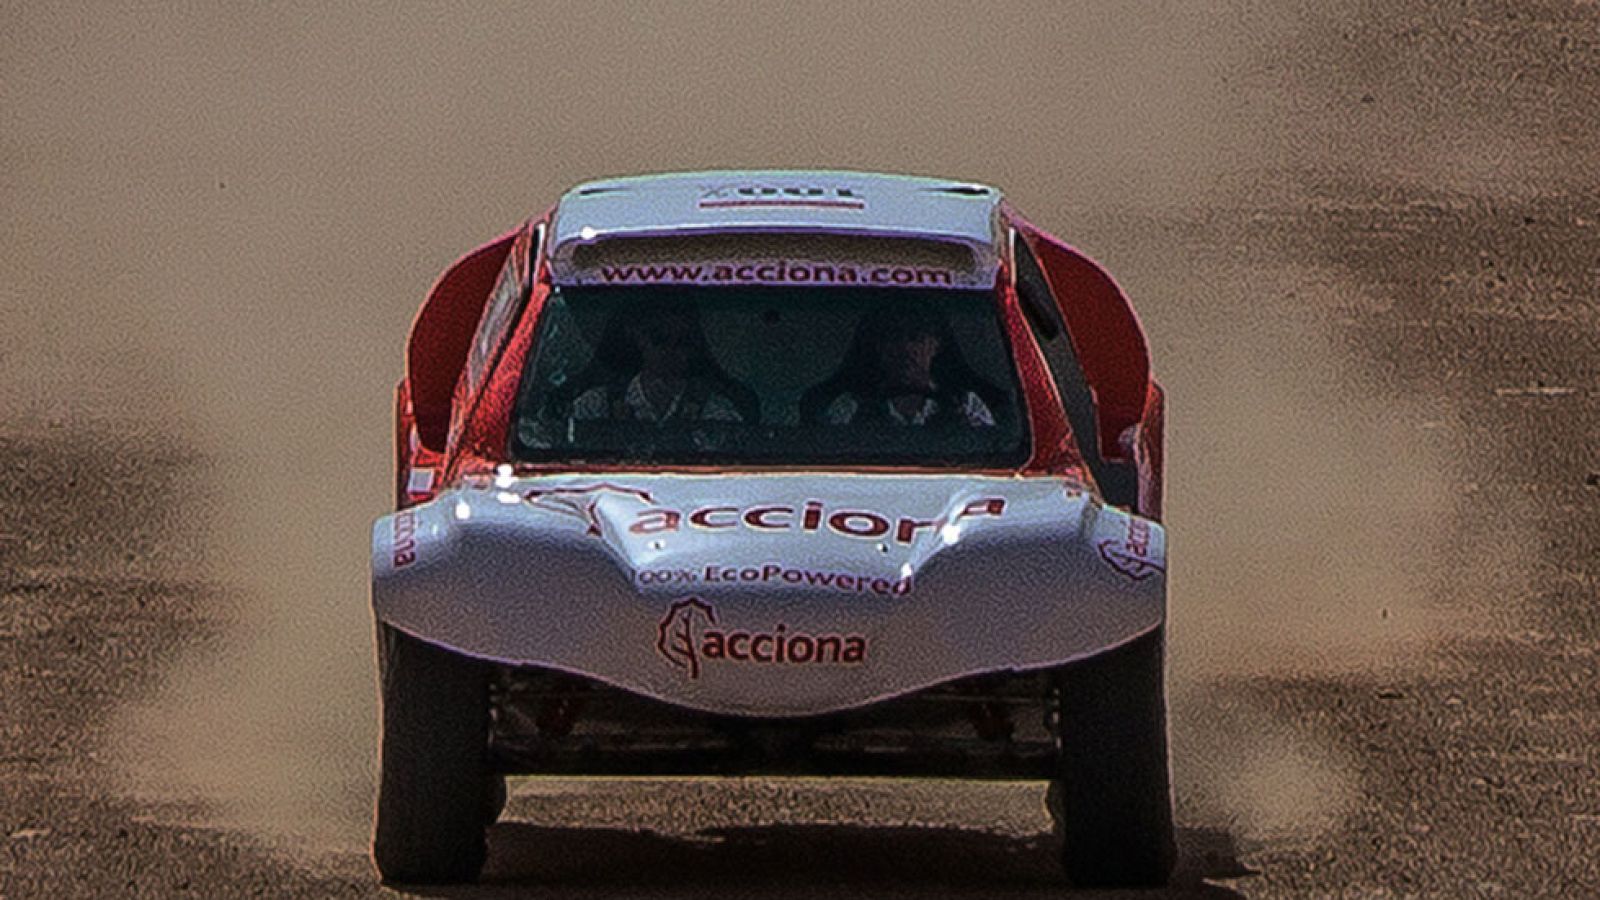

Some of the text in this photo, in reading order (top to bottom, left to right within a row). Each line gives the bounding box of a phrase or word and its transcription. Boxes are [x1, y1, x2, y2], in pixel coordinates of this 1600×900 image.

[601, 260, 952, 285] www.acciona.com
[704, 564, 913, 596] EcoPowered
[703, 624, 867, 663] acciona
